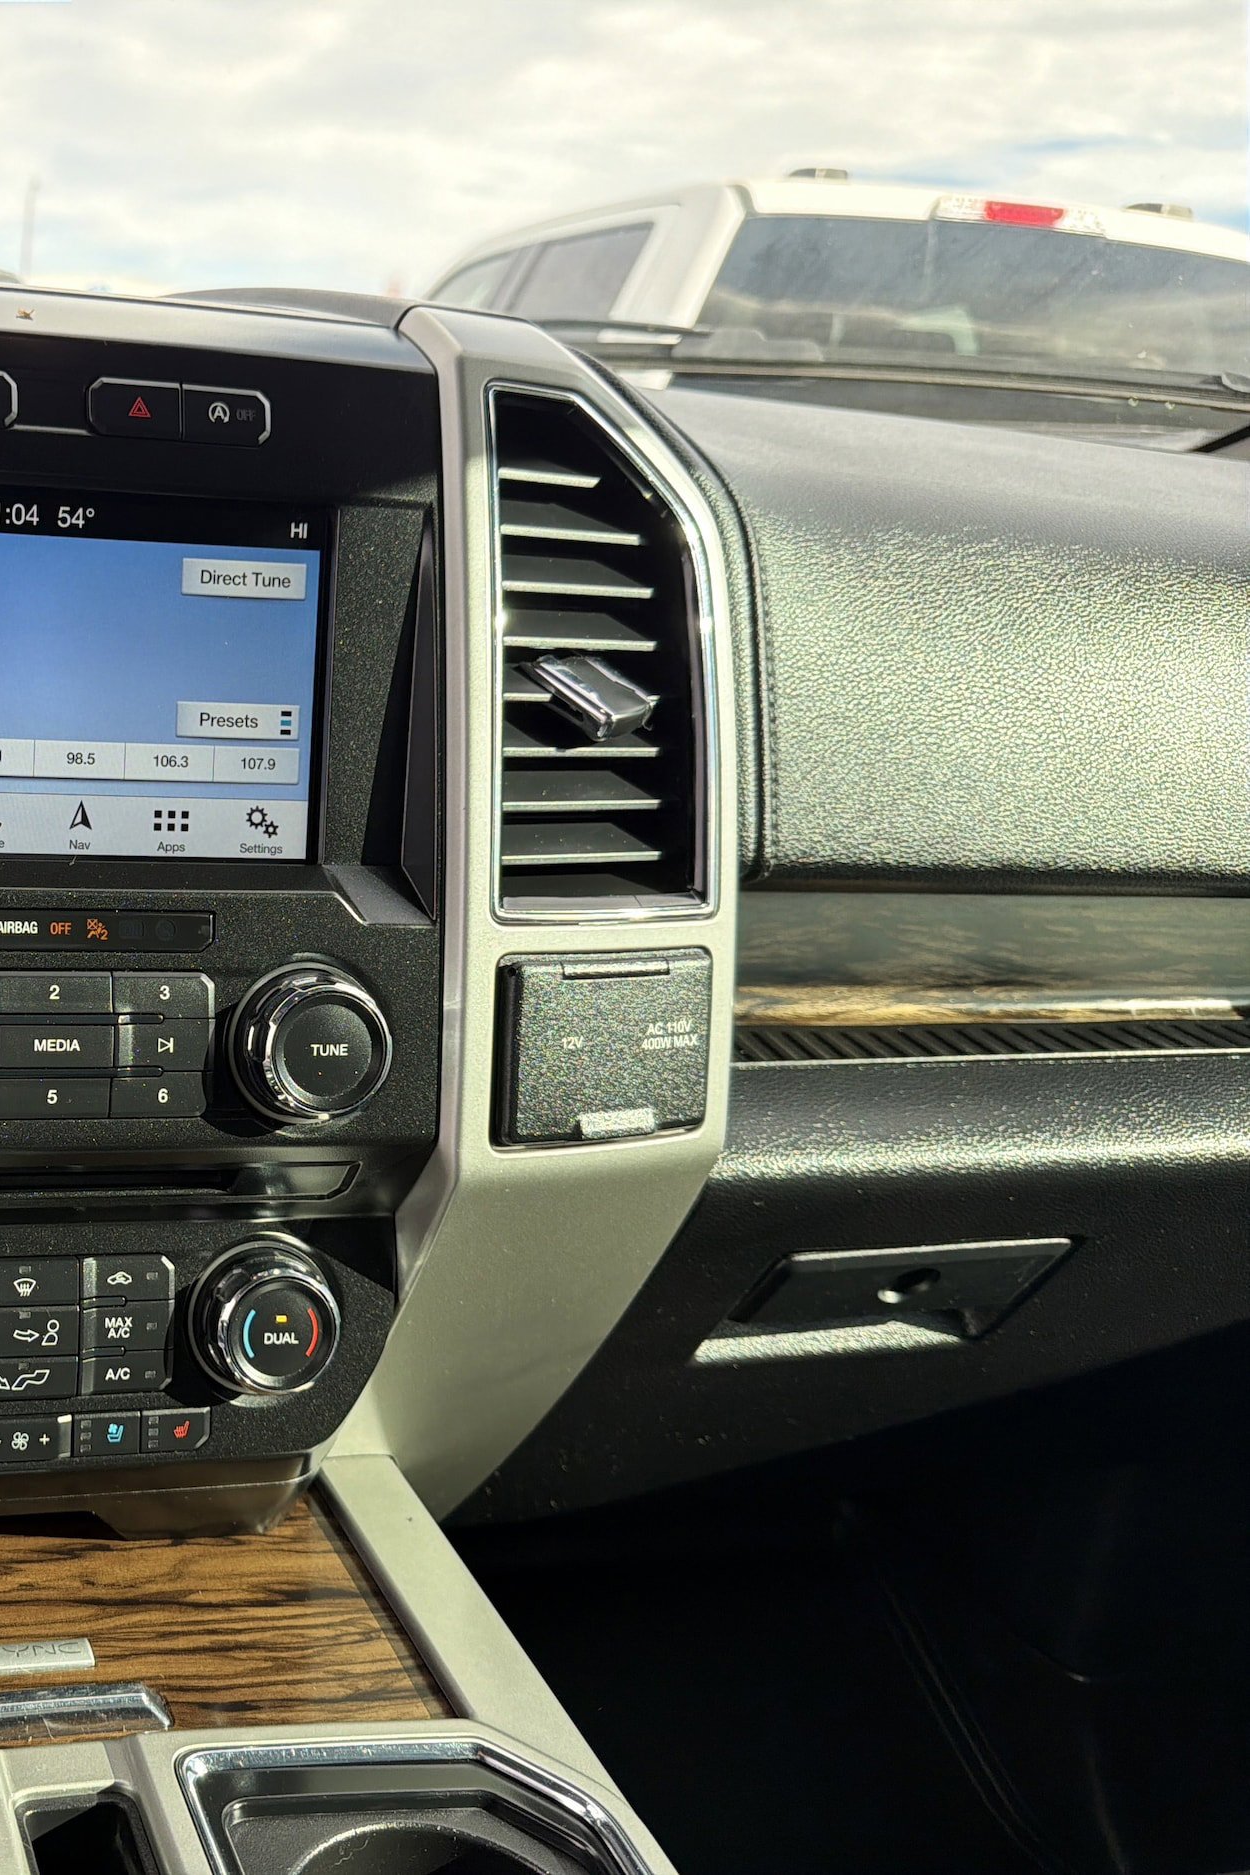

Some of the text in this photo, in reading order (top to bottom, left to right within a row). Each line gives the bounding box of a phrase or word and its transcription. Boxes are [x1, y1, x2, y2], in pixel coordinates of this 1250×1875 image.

[235, 408, 256, 422] OFF
[289, 522, 309, 540] HI
[200, 569, 292, 589] Direct Tune
[199, 712, 259, 729] Presets
[66, 752, 96, 766] 98.5
[153, 754, 189, 769] 106.3
[240, 757, 276, 771] 107.9
[69, 839, 91, 851] Nav
[156, 841, 186, 854] Apps
[239, 842, 283, 856] Settings
[49, 921, 73, 936] OFF
[48, 984, 61, 1000] 2
[158, 984, 171, 1001] 3
[33, 1038, 81, 1052] MEDIA
[561, 1035, 584, 1050] 12V
[672, 1033, 699, 1048] MAX
[310, 1043, 349, 1057] TUNE
[46, 1089, 59, 1105] 5
[157, 1088, 169, 1103] 6
[104, 1317, 133, 1329] MAX
[107, 1327, 131, 1340] A/C
[263, 1332, 299, 1346] DUAL
[104, 1367, 131, 1381] A/C
